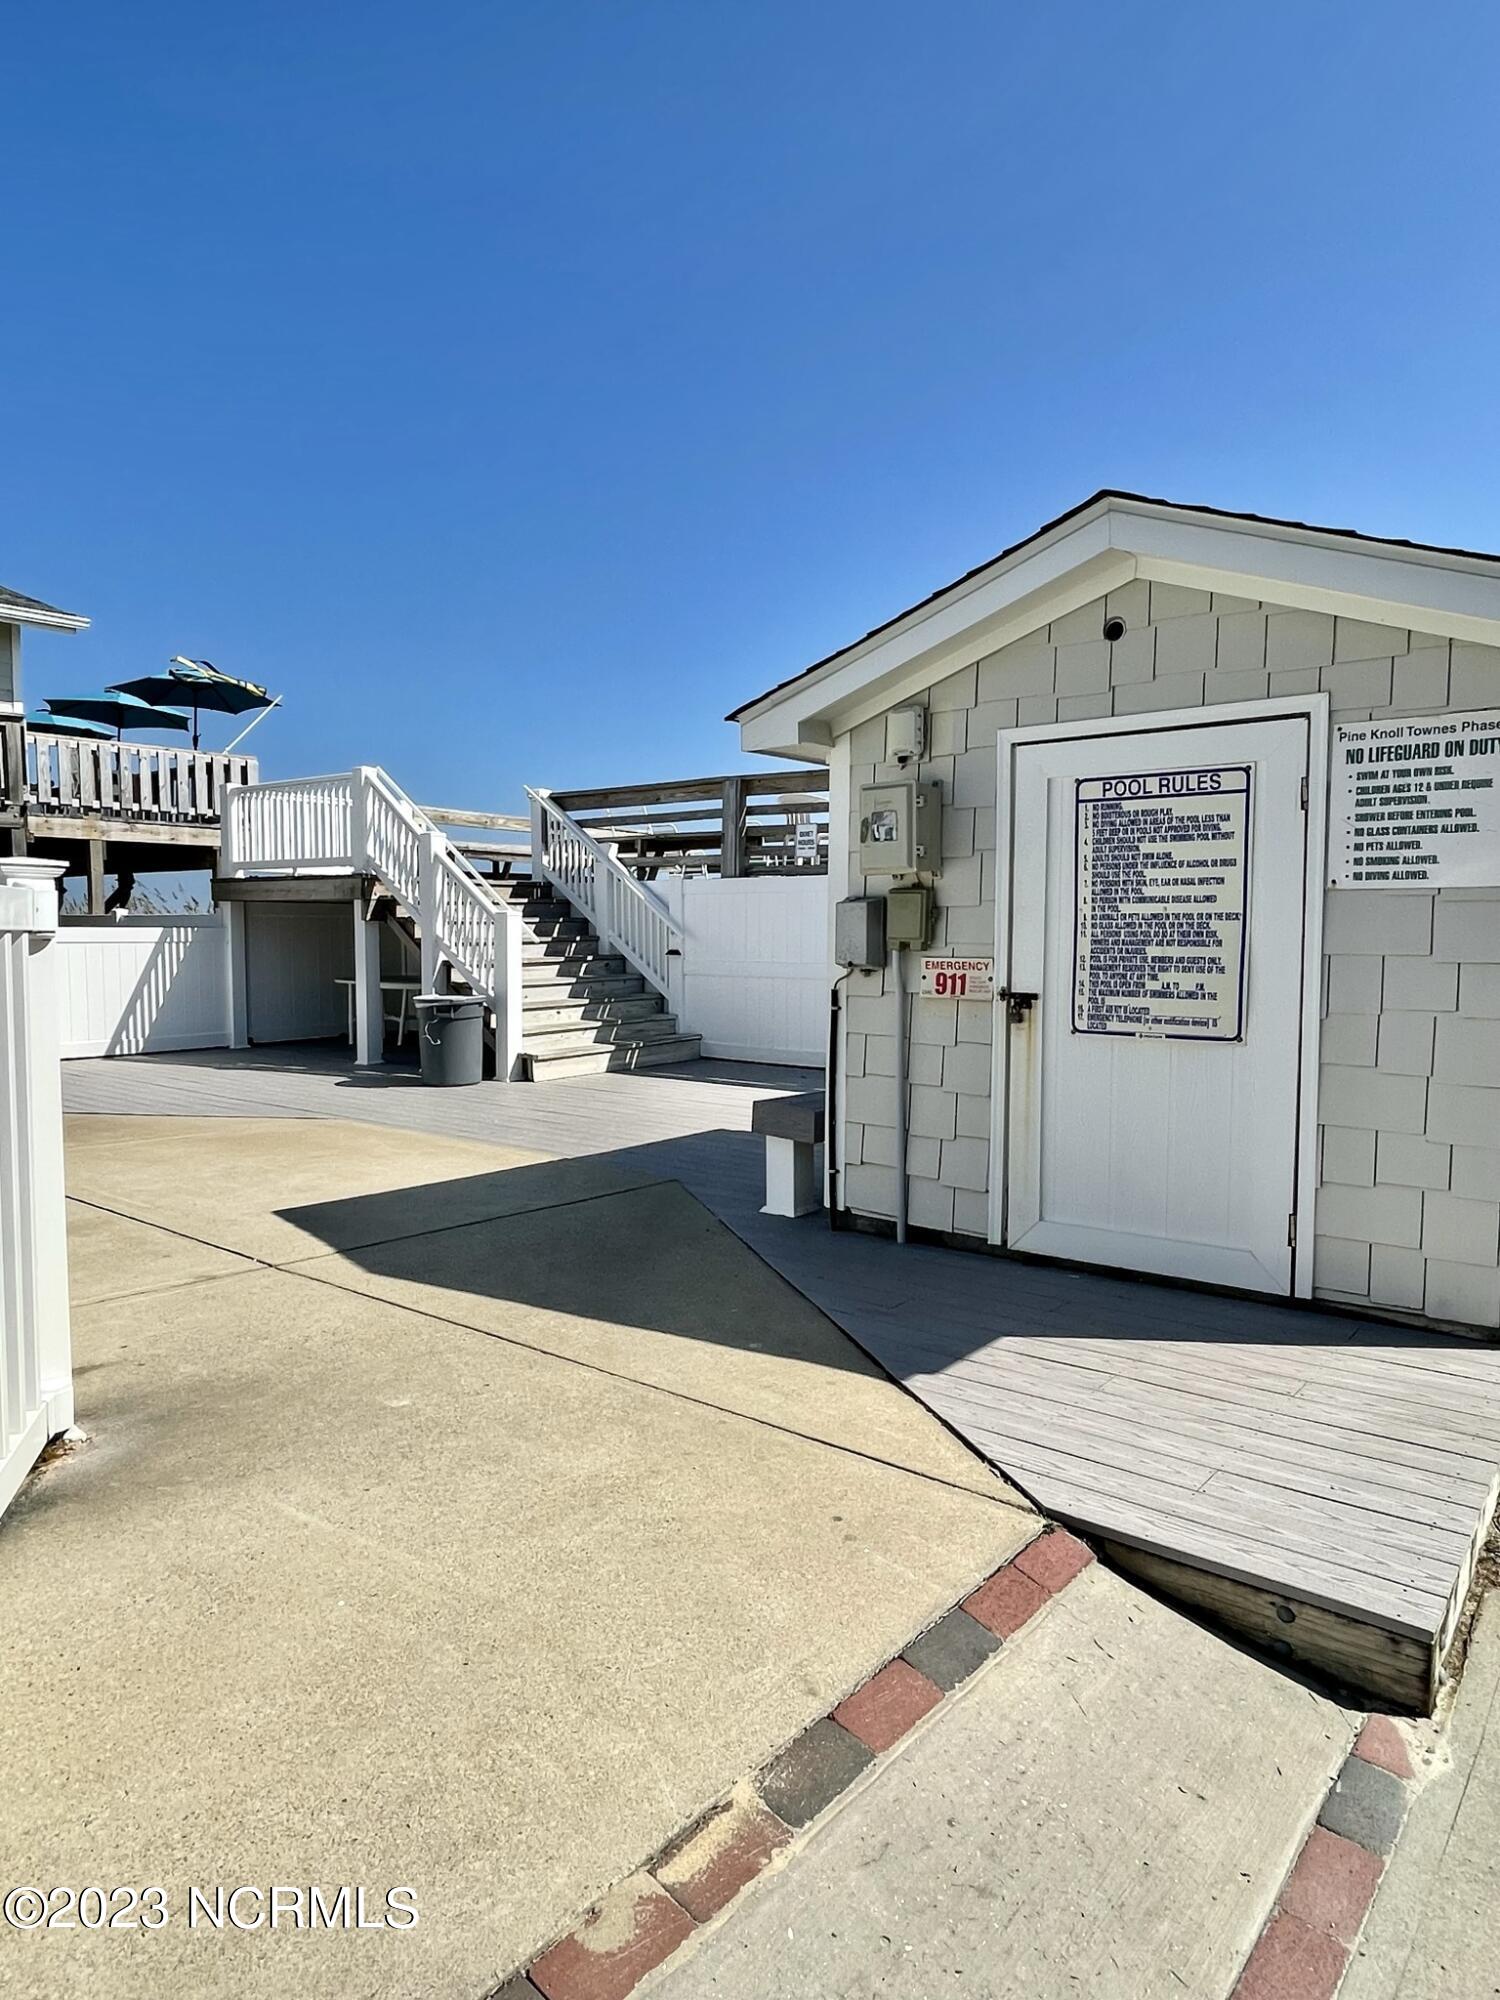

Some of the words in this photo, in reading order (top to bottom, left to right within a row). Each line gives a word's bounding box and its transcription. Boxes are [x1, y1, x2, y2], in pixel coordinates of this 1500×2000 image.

[1340, 732, 1366, 742] Pine
[1370, 727, 1404, 740] Knoll
[1406, 724, 1456, 736] Townes
[1346, 748, 1364, 764] NO
[1368, 742, 1440, 764] LIFEGUARD
[1445, 740, 1464, 757] ON
[1470, 737, 1500, 756] DUT
[1356, 770, 1378, 780] SWIM
[1380, 770, 1389, 779] AT
[1392, 768, 1412, 778] YOUR
[1414, 768, 1432, 777] OWN
[1102, 778, 1152, 798] POOL
[1158, 773, 1222, 794] RULES
[1356, 785, 1390, 796] CHILDREN
[1392, 783, 1411, 793] AGES
[1414, 782, 1424, 792] 12
[1434, 780, 1460, 791] UNDER
[1462, 778, 1494, 790] REQUIRE
[1355, 798, 1376, 808] ADULT
[1175, 816, 1185, 824] THE
[1187, 815, 1200, 823] POOL
[1202, 814, 1214, 822] LESS
[1216, 814, 1230, 822] THAN
[1354, 812, 1385, 822] SHOWER
[1388, 810, 1414, 820] BEFORE
[1416, 809, 1452, 820] ENTERING
[1454, 808, 1476, 818] POOL.
[1354, 828, 1364, 837] NO
[1366, 826, 1390, 836] GLASS
[1392, 824, 1438, 836] CONTAINERS
[1440, 823, 1480, 834] ALLOWED.
[1354, 842, 1364, 852] NO
[1366, 842, 1384, 851] PETS
[1386, 840, 1423, 850] ALLOWED.
[1353, 857, 1364, 866] NO
[1365, 856, 1400, 866] SMOKING
[1402, 855, 1440, 865] ALLOWED.
[1352, 872, 1363, 880] NO
[1365, 871, 1390, 880] DIVING
[1392, 870, 1430, 880] ALLOWED.
[925, 960, 990, 971] EMERGENCY
[1216, 966, 1226, 974] THE
[935, 972, 966, 996] 911
[1207, 992, 1218, 1000] THE
